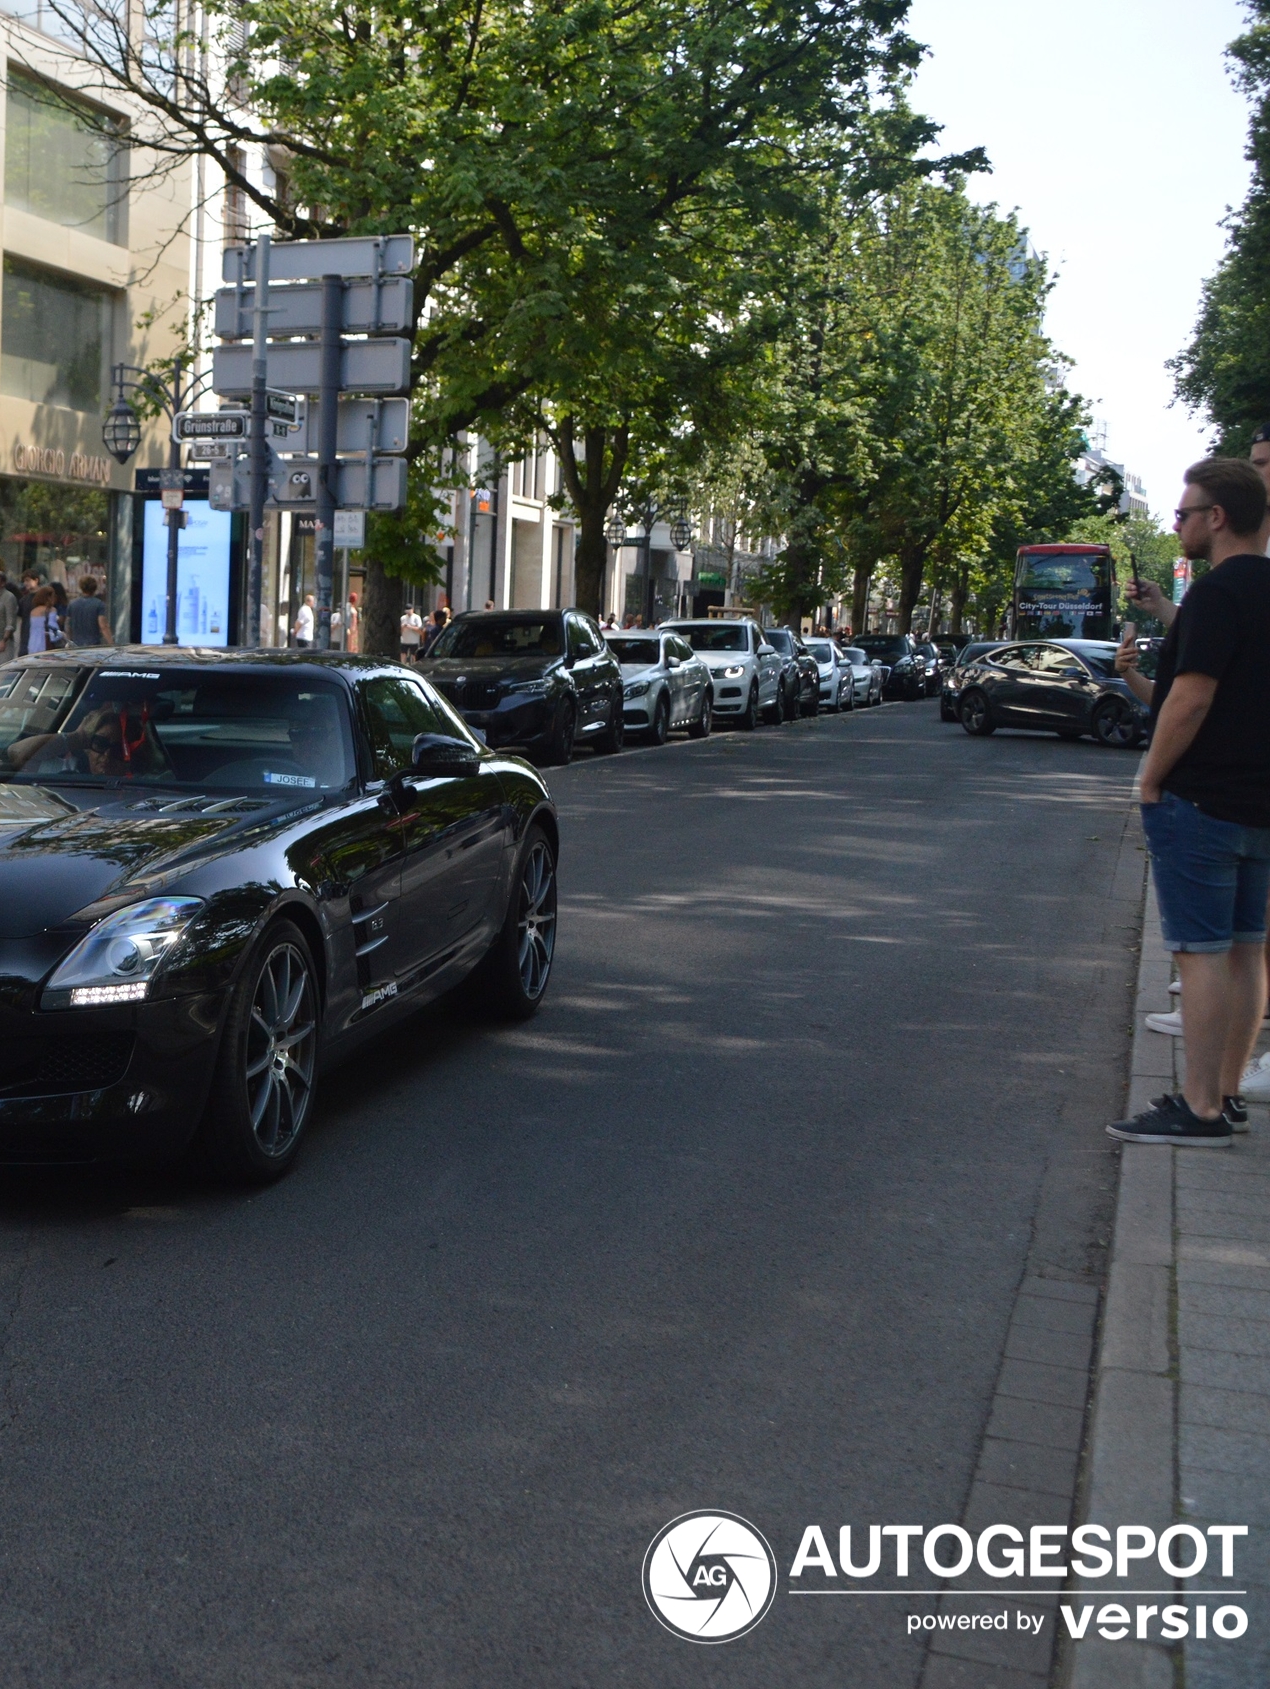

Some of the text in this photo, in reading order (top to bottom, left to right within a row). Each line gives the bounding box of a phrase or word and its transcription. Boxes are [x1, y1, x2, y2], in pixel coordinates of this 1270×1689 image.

[184, 419, 238, 434] Grünstraße
[14, 443, 65, 475] GIORGIO
[1019, 602, 1103, 610] City-Tour Düsseldorf
